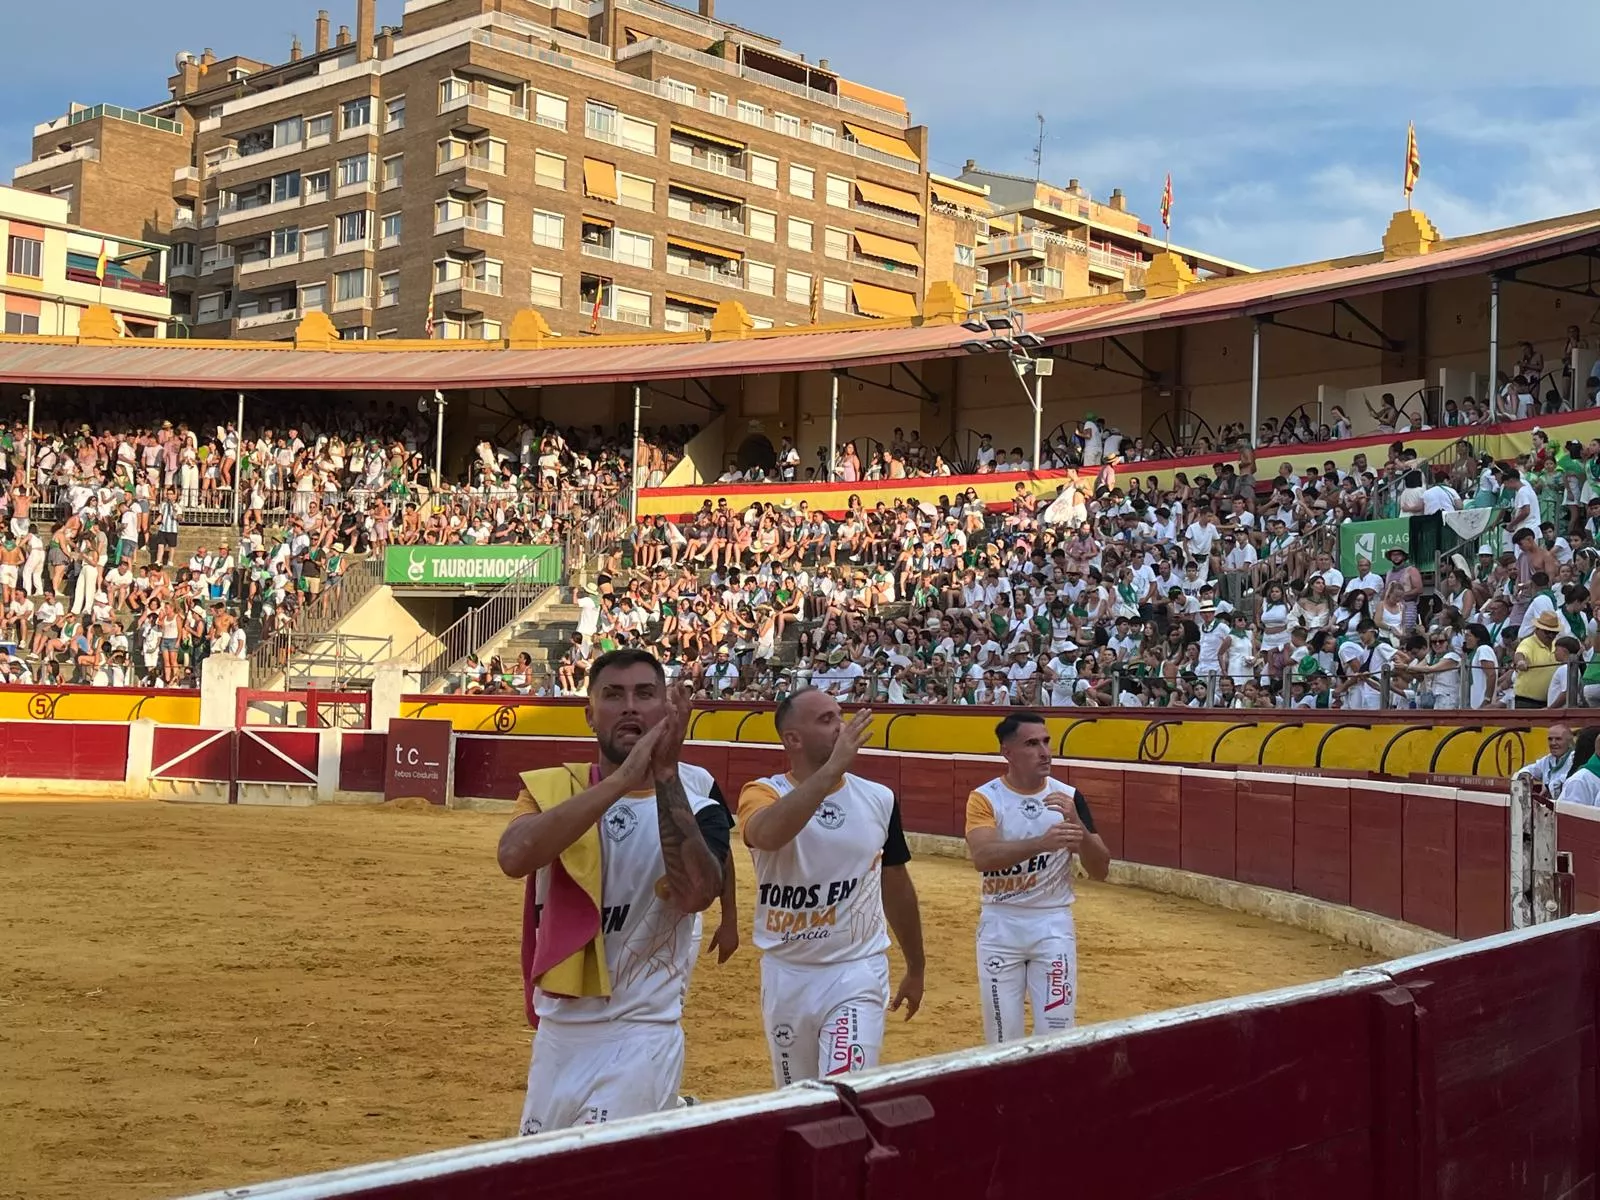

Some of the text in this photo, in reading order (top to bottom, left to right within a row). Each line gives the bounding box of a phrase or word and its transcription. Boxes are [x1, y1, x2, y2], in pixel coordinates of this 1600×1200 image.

[1380, 532, 1410, 545] ARAG
[759, 878, 858, 910] TOROS EN
